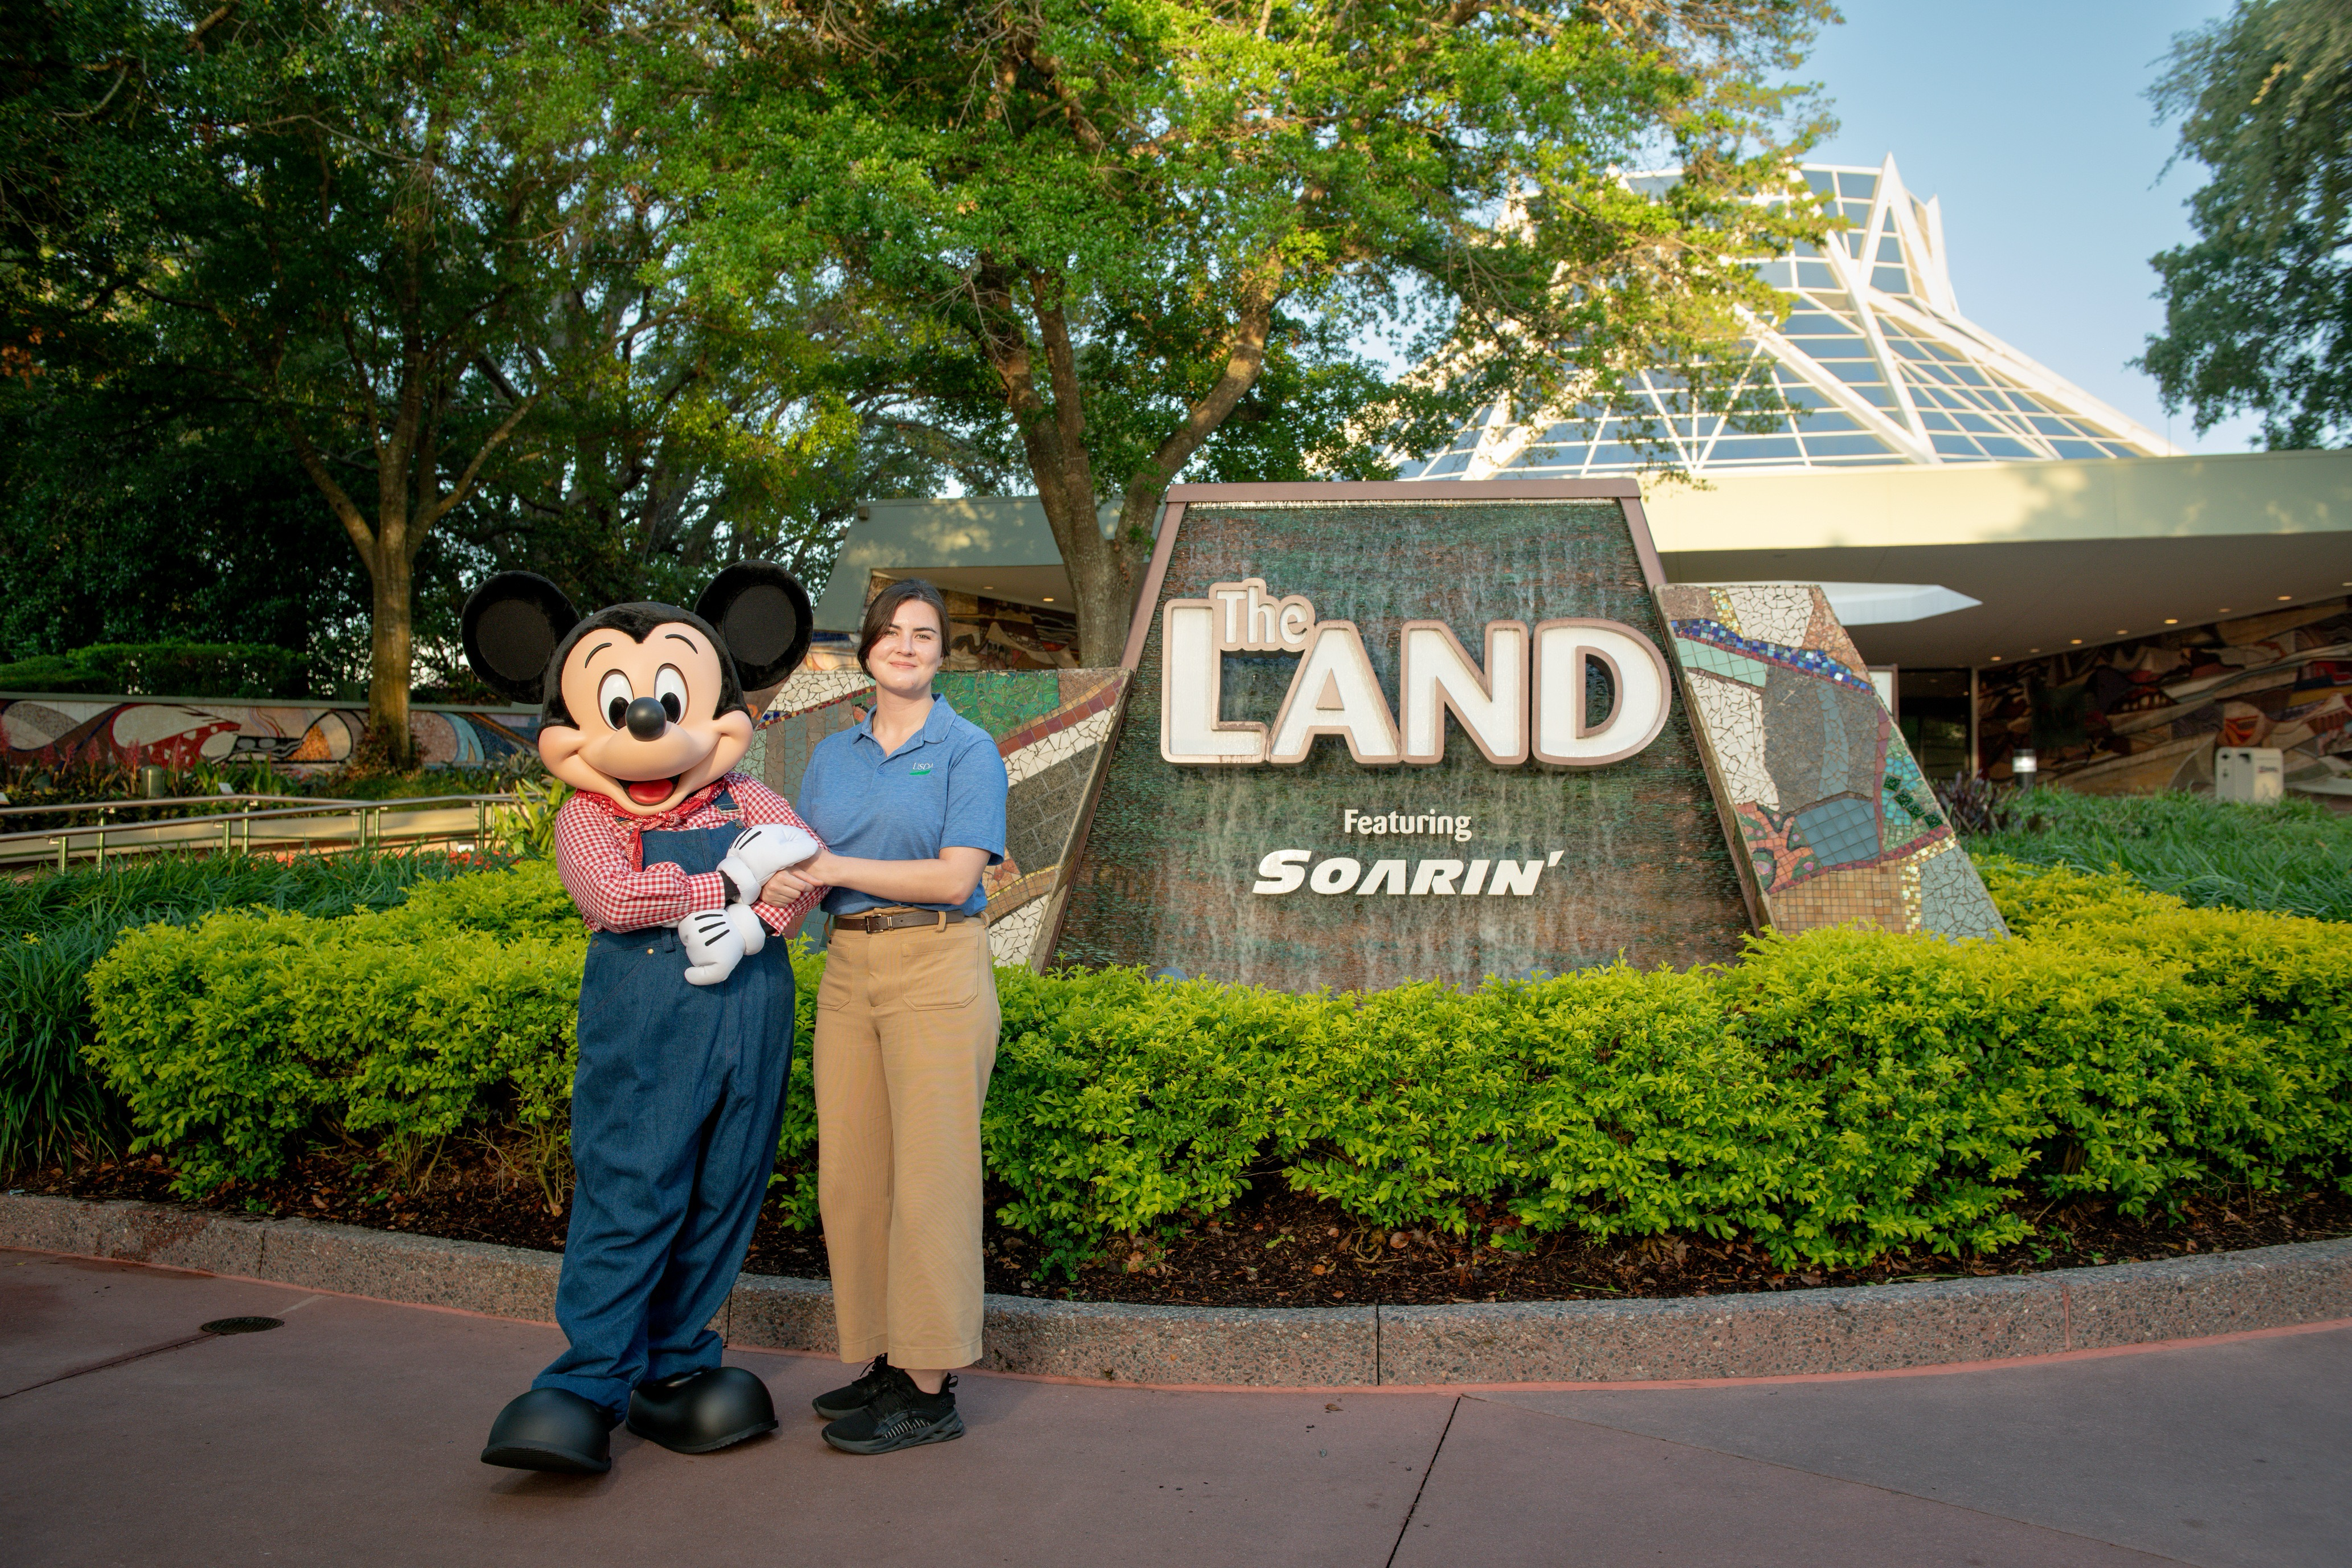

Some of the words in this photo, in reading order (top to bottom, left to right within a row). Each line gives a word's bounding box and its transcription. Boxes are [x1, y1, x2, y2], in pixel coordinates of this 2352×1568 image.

[1216, 585, 1311, 645] The
[1163, 603, 1668, 764] LAND
[1344, 808, 1472, 842] Featuring
